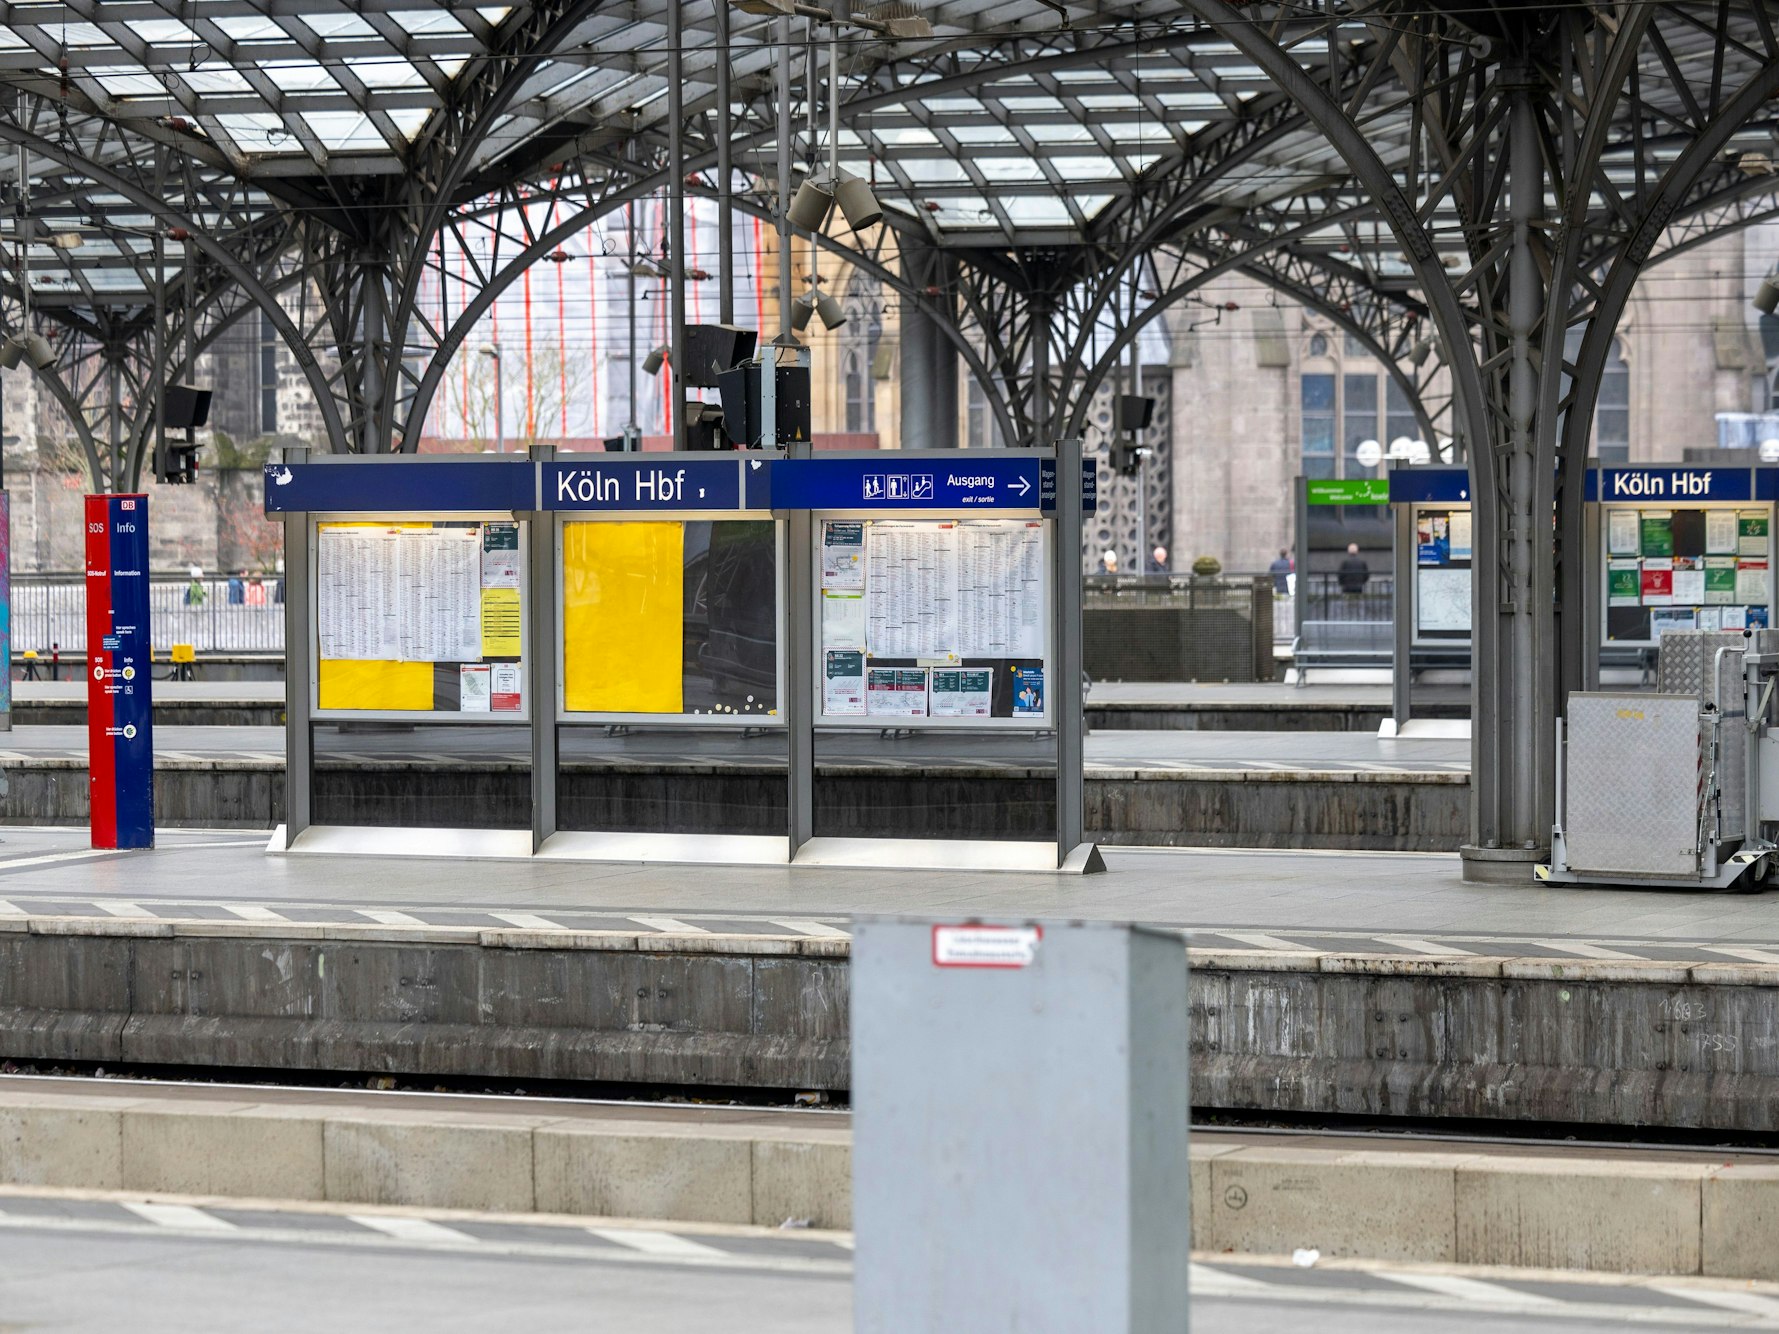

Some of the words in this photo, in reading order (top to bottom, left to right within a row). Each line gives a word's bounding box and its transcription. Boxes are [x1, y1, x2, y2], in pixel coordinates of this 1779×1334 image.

[557, 470, 620, 502] Köln
[635, 469, 686, 501] Hbf
[946, 473, 995, 489] Ausgang
[1614, 472, 1664, 495] Köln
[1671, 472, 1712, 495] Hbf
[122, 501, 134, 509] DB
[962, 495, 974, 503] exit
[88, 522, 104, 534] SOS
[116, 522, 136, 534] Info
